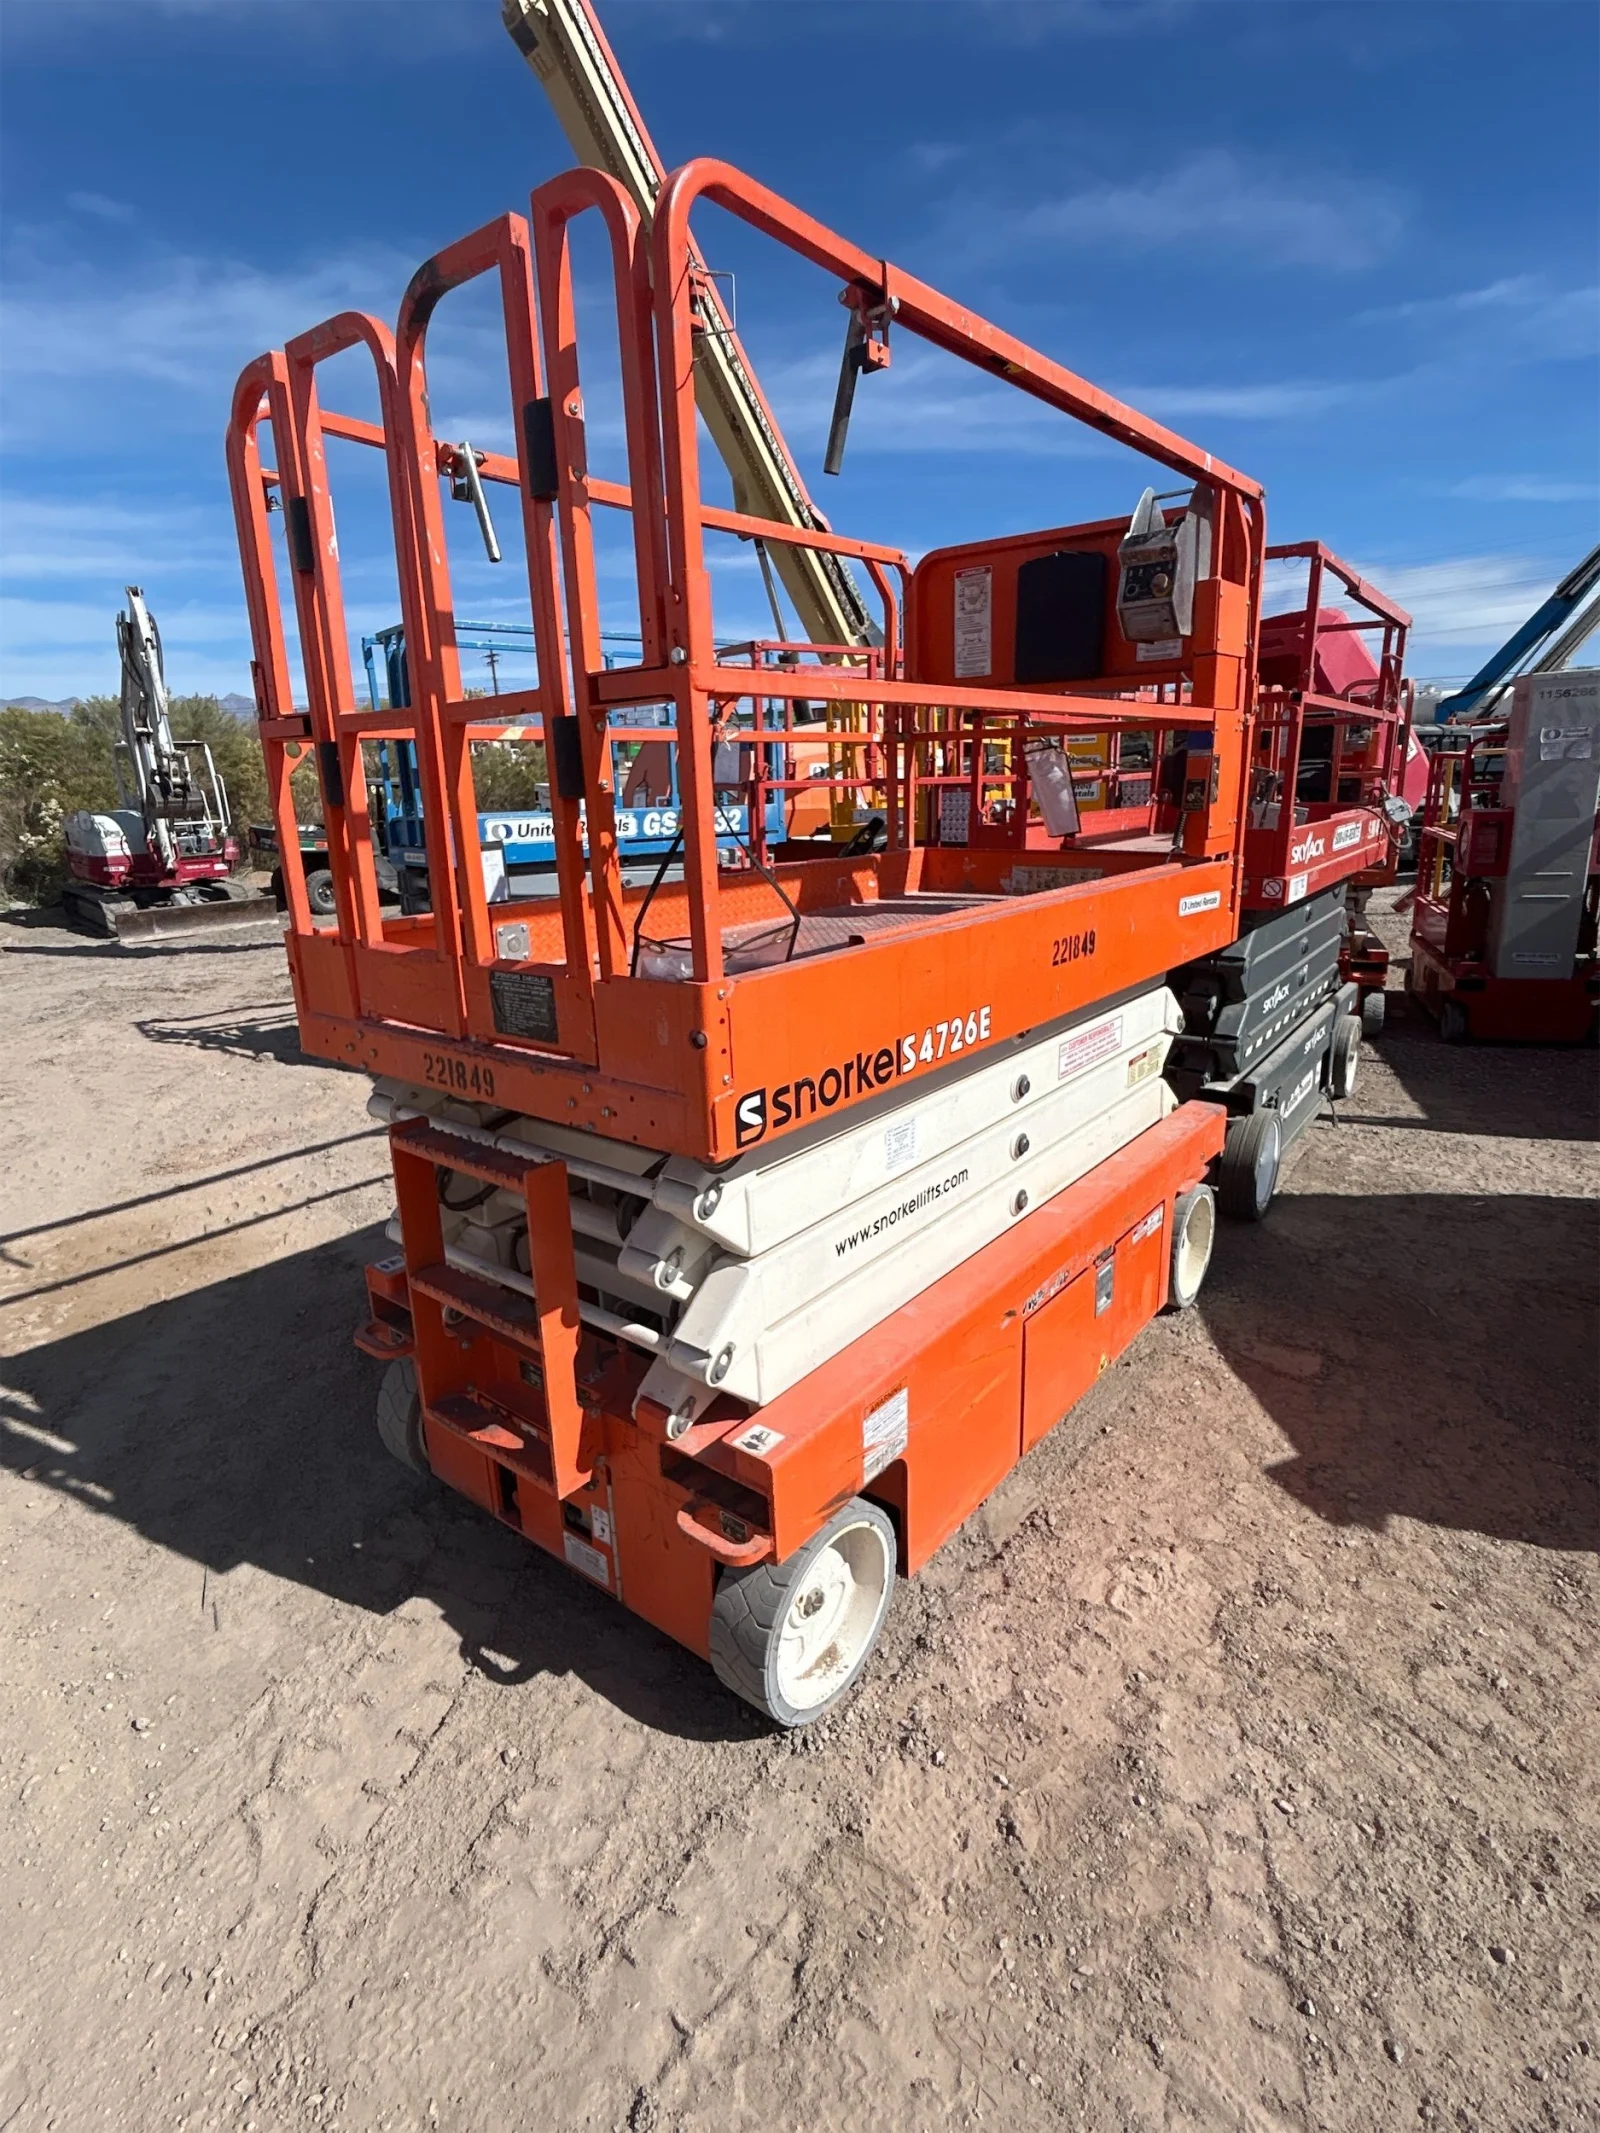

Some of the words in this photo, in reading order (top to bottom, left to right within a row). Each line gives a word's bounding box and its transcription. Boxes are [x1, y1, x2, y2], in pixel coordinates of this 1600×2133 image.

[517, 822, 555, 838] Unit
[1291, 831, 1325, 864] SKYJACK
[1052, 929, 1096, 967] 221849
[1263, 983, 1290, 1014] SKYJACK
[423, 1052, 495, 1097] 221849
[773, 1039, 902, 1128] snorkel
[901, 1004, 992, 1075] S4726E
[835, 1168, 969, 1257] www.snorkellifts.com
